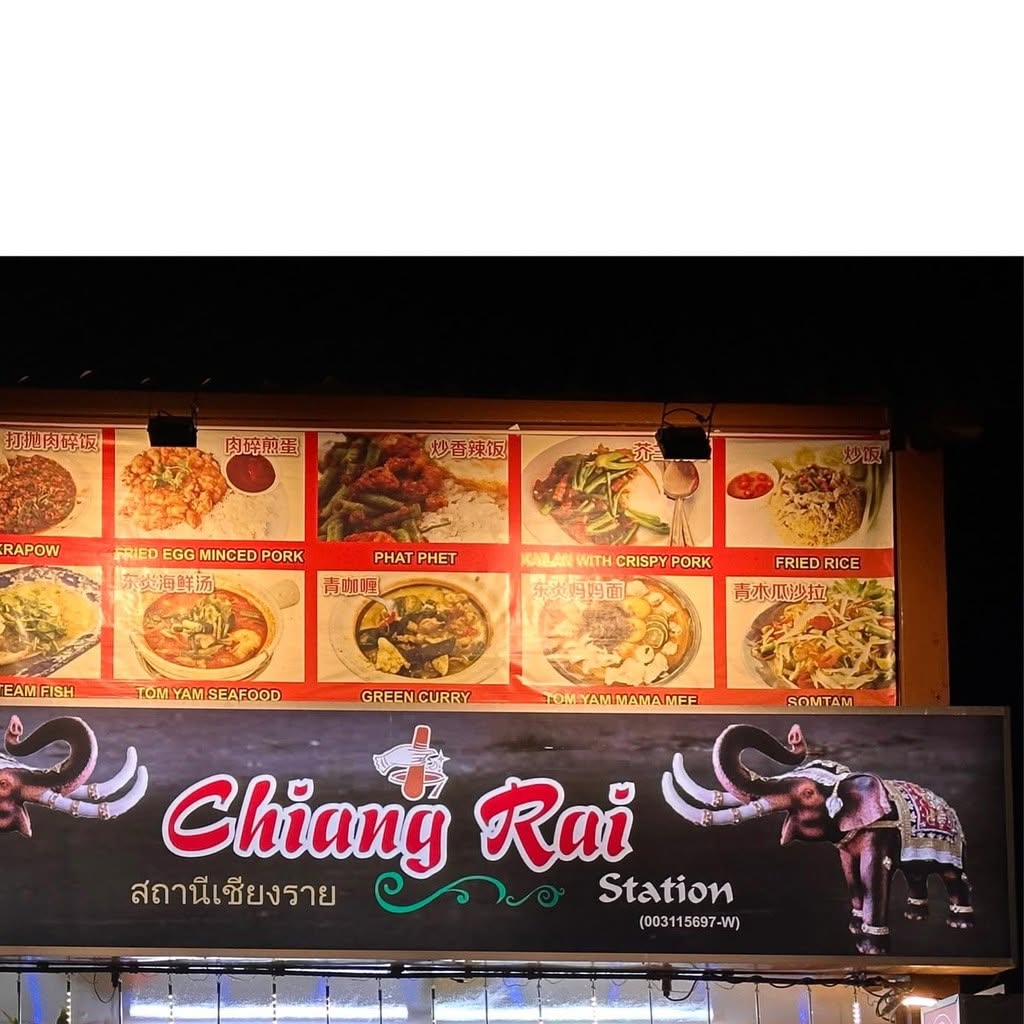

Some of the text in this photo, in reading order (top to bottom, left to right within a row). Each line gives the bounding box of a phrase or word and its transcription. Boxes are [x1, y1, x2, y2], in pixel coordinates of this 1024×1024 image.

[5, 431, 98, 453] 打抛肉碎饭
[224, 436, 299, 456] 肉碎煎蛋
[430, 440, 506, 459] 炒香辣饭
[843, 446, 882, 464] 炒饭
[114, 547, 304, 563] FRIED EGG MINCED PORK
[374, 551, 457, 565] PHAT PHET
[577, 554, 611, 567] WITH
[616, 555, 667, 568] CRISPY
[671, 556, 712, 569] PORK
[775, 557, 860, 569] FRIED RICE
[121, 573, 214, 593] 东炎海鲜汤
[323, 576, 379, 595] 青咖喱
[532, 581, 625, 600] 东炎妈妈面
[733, 583, 827, 601] 青木瓜沙拉
[40, 685, 74, 698] FISH
[137, 686, 281, 701] TOM YAM SEAFOOD
[361, 690, 471, 704] GREEN CURRY
[545, 694, 698, 706] TOM YAM MAMA MEE
[787, 696, 853, 706] SOMTAM
[161, 773, 636, 880] Chiang Rai
[130, 874, 337, 907] สถานีเชียงราย
[598, 872, 734, 905] Station
[639, 915, 741, 931] (003115697-W)
